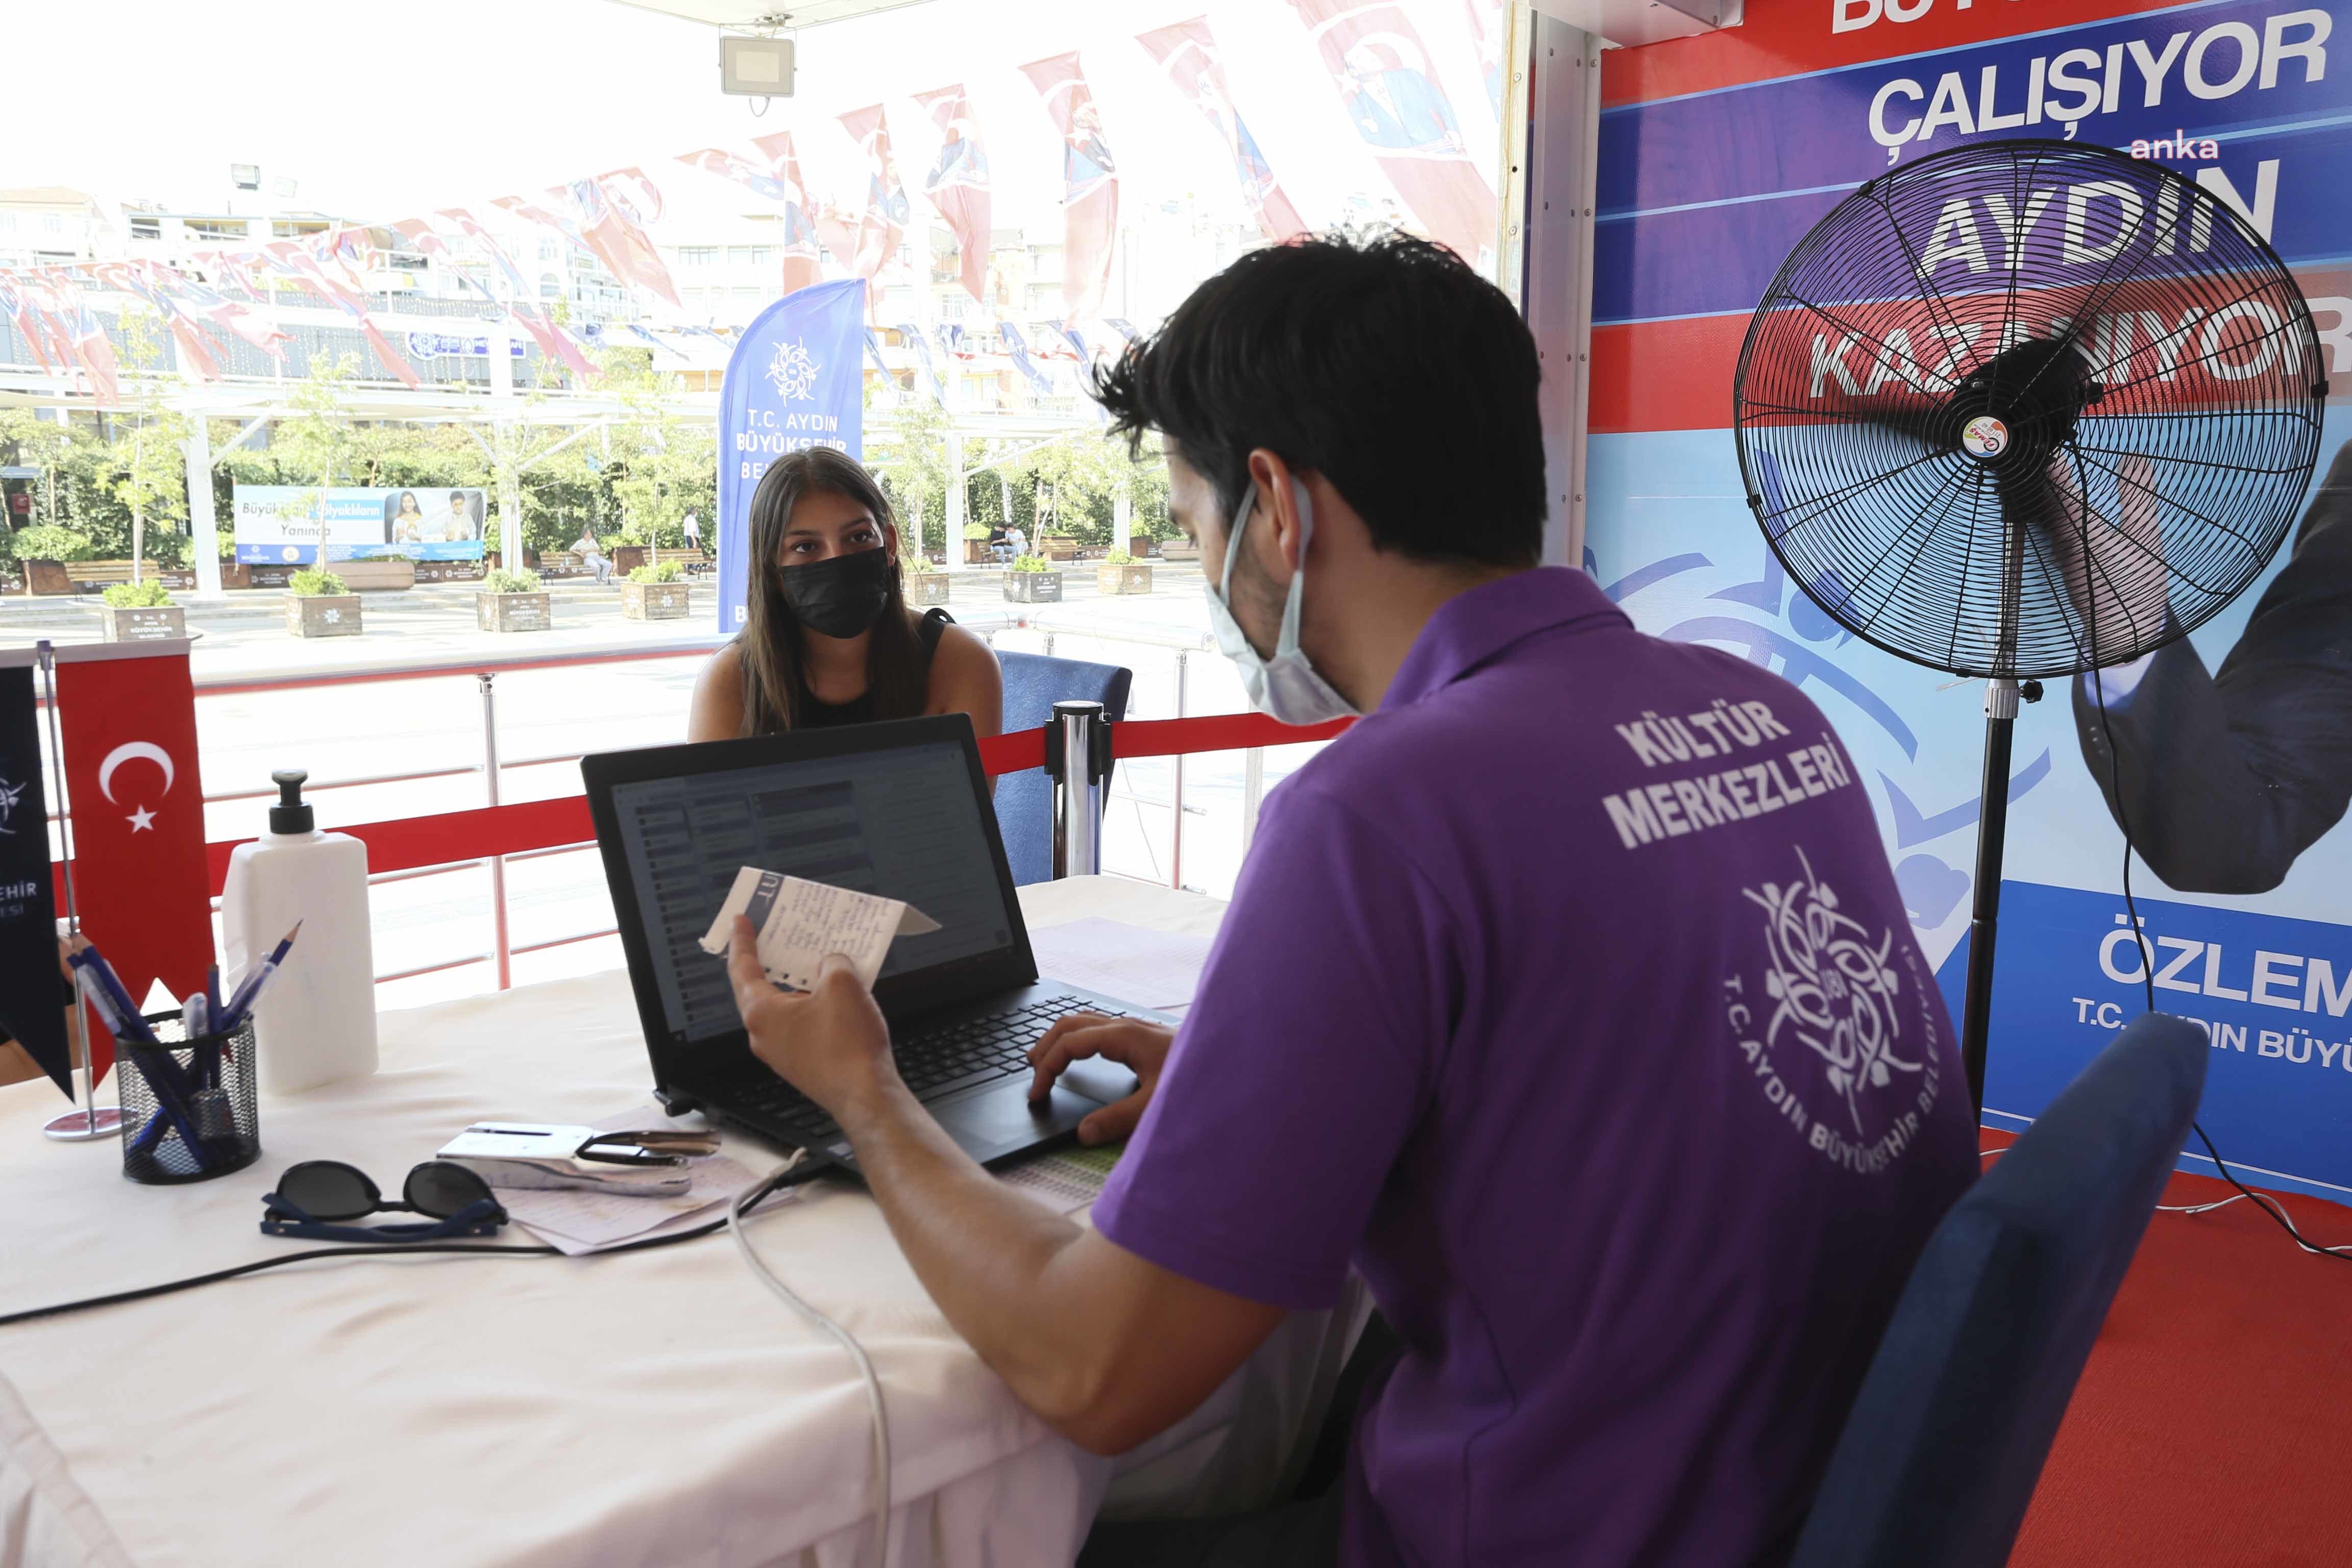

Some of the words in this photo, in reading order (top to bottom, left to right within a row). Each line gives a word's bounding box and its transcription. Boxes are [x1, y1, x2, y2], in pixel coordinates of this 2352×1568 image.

[1869, 9, 2333, 165] ÇALIŞIYOR
[1914, 159, 2280, 279] AYDIN
[747, 409, 780, 429] T.C.
[786, 411, 838, 432] AYDIN
[1614, 698, 1791, 768] KÜLTÜR
[1602, 731, 1851, 849] MERKEZLERİ
[2099, 914, 2352, 1017] ÖZLEM
[1739, 1040, 1807, 1132] AYDIN
